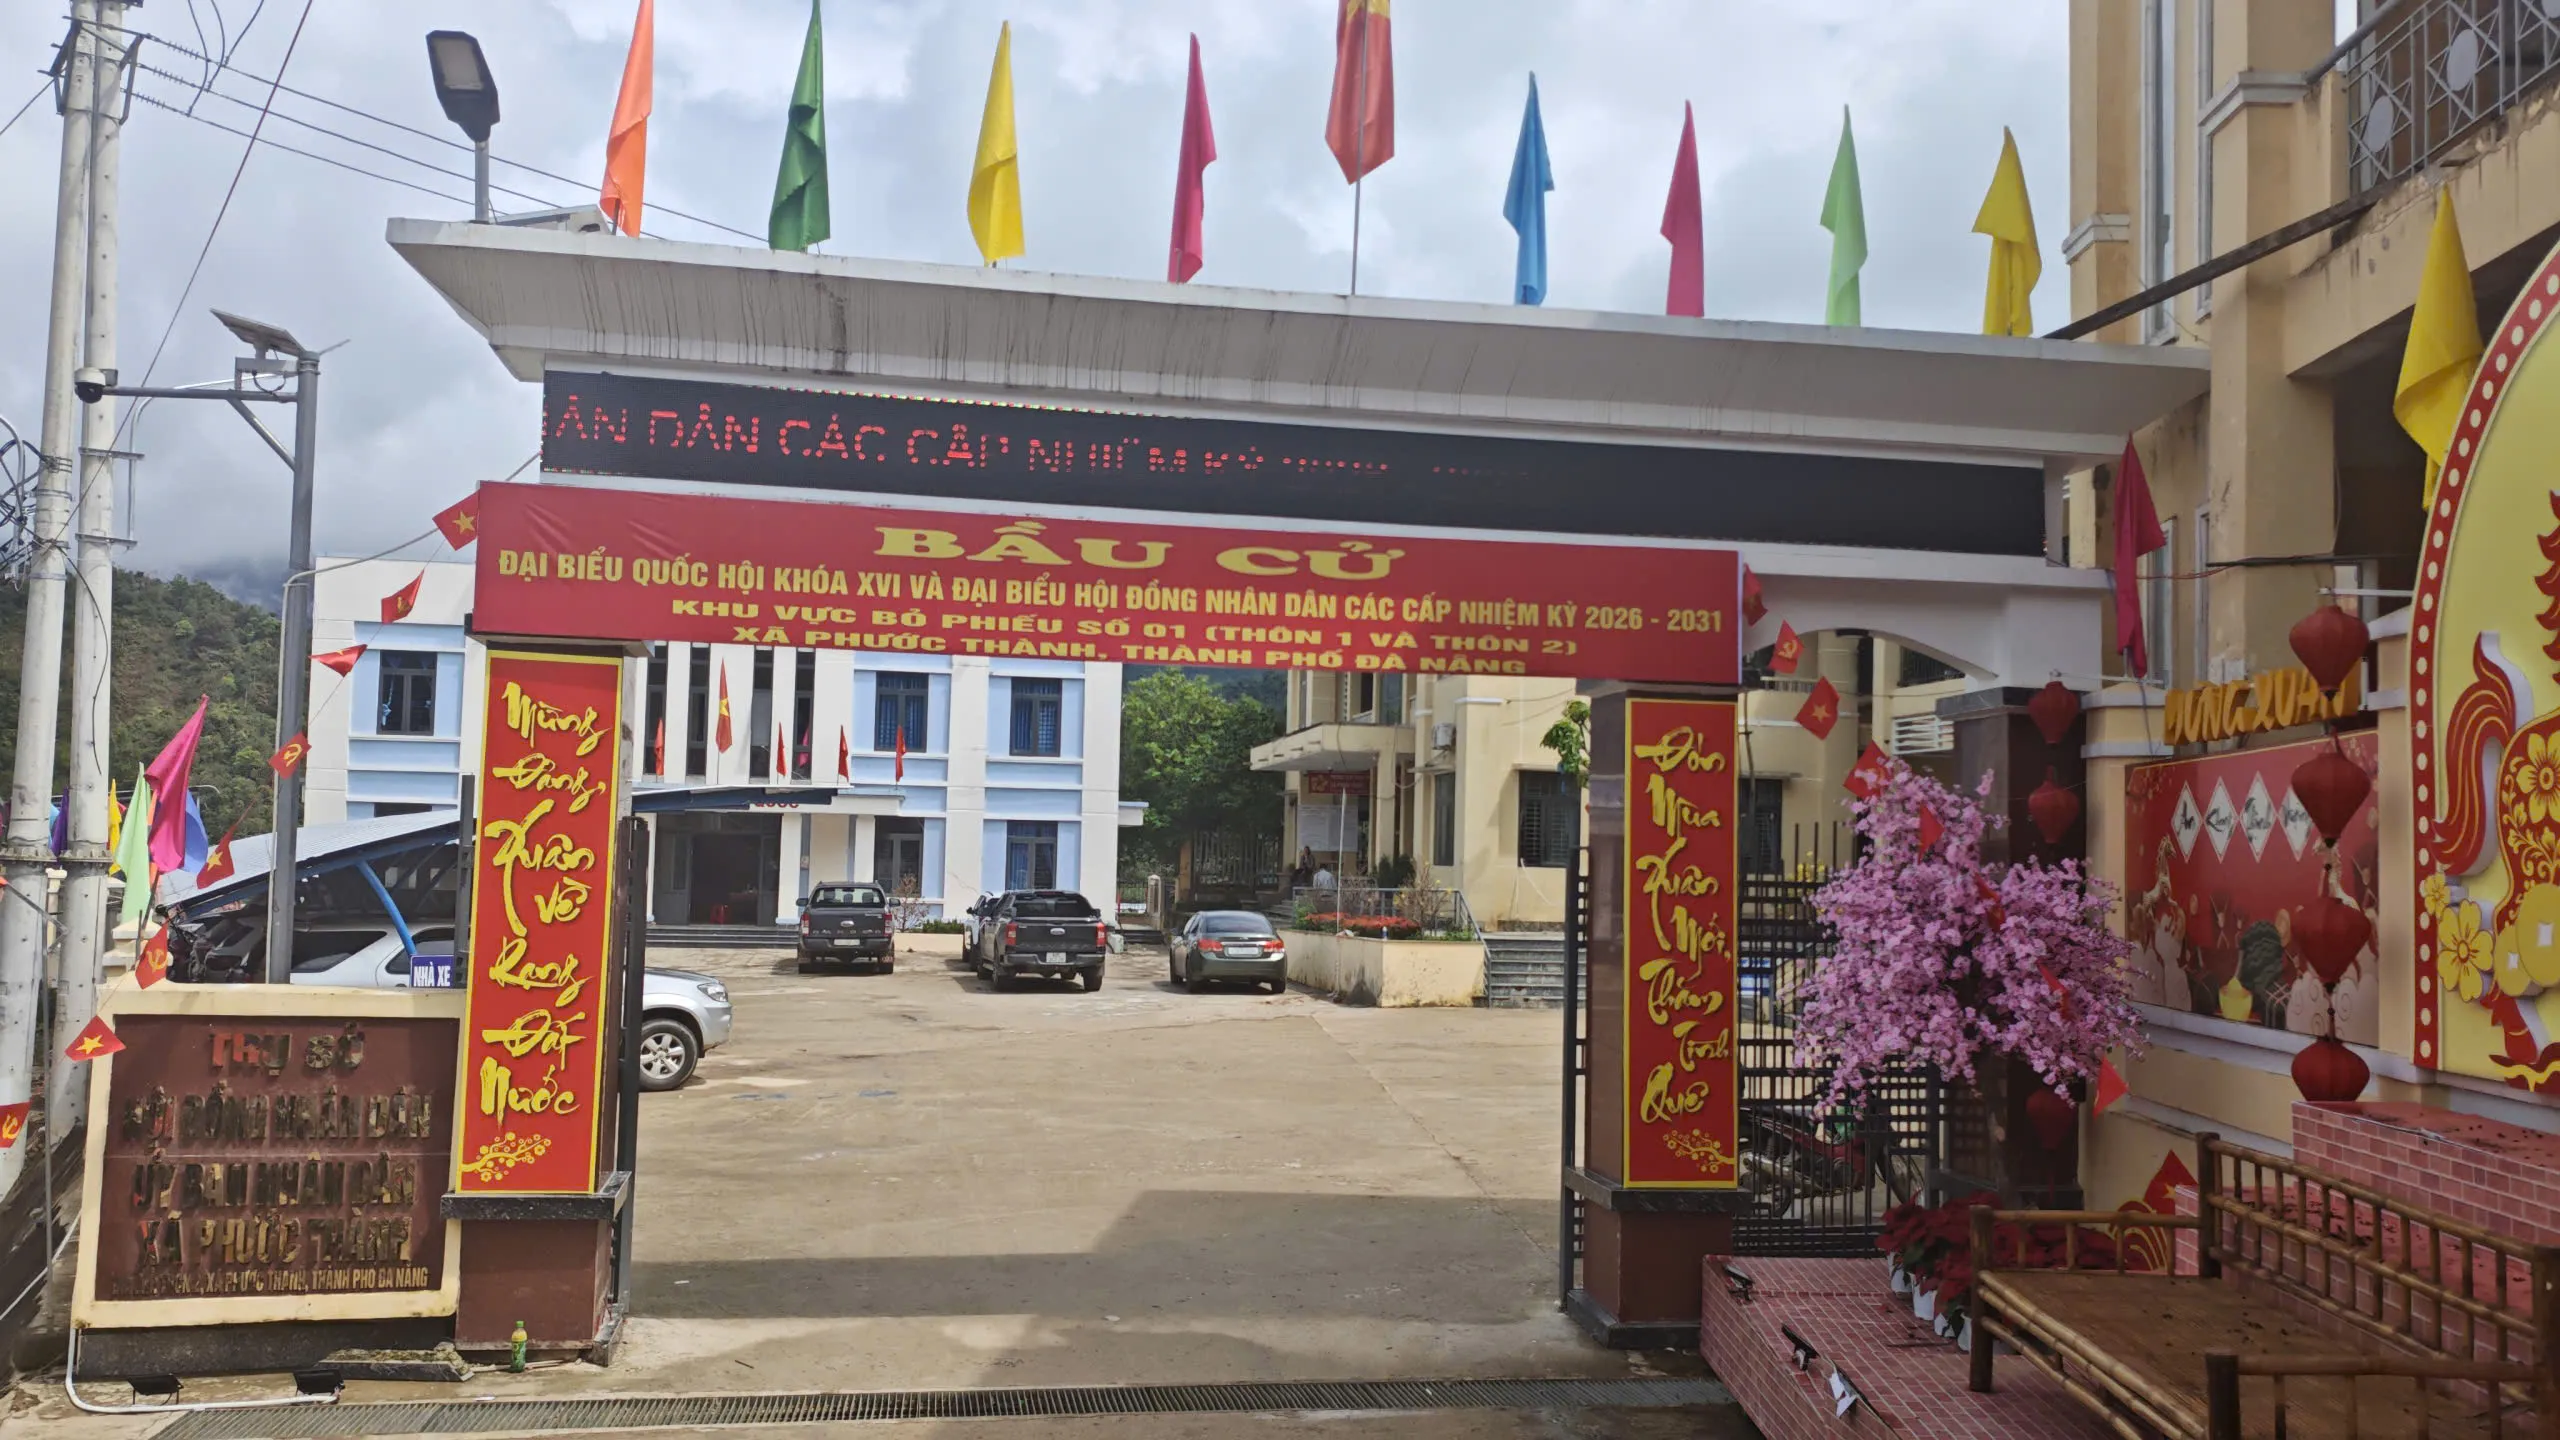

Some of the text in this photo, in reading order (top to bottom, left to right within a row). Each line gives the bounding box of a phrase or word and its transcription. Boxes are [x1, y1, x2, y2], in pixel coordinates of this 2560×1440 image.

[543, 395, 627, 441] ÂN
[780, 413, 885, 461] CÁC
[873, 521, 1405, 580] BẦU CỬ
[499, 549, 547, 582] ĐẠI
[557, 546, 623, 581] BIỂU
[632, 552, 708, 587] QUỐC
[718, 560, 764, 595] HỘI
[774, 564, 848, 595] KHÓA
[856, 572, 901, 599] XVI
[910, 570, 944, 601] VÀ
[951, 577, 997, 608] ĐẠI
[1005, 572, 1066, 607] BIỂU
[1075, 579, 1118, 613] HỘI
[1126, 578, 1198, 613] ĐỒNG
[1205, 586, 1277, 617] NHÂN
[1285, 589, 1337, 619] DÂN
[1344, 592, 1394, 621] CÁC
[1402, 592, 1451, 623] CẤP
[1459, 597, 1539, 631] NHIỆM
[1547, 599, 1578, 628] KỲ
[1585, 606, 1643, 630] 2026
[1667, 609, 1722, 632] 2031
[672, 599, 1578, 656] KHU VỰC BỎ PHIẾU SỐ 01 (THÔN 1 VÀ THÔN 2)
[733, 626, 1526, 674] XÃ PHƯỚC THÀNH, THÀNH PHỐ ĐÀ NẴNG
[501, 681, 611, 756] Mừng
[1634, 726, 1725, 772] Đón
[1645, 773, 1721, 838] Mùa
[484, 799, 595, 937] Xuân
[1635, 836, 1719, 951] Xuân
[534, 876, 593, 923] Về
[413, 961, 451, 987] NHÀ XE
[481, 1009, 586, 1071] Đất
[480, 1056, 581, 1129] Nước
[1640, 1062, 1710, 1123] Quê
